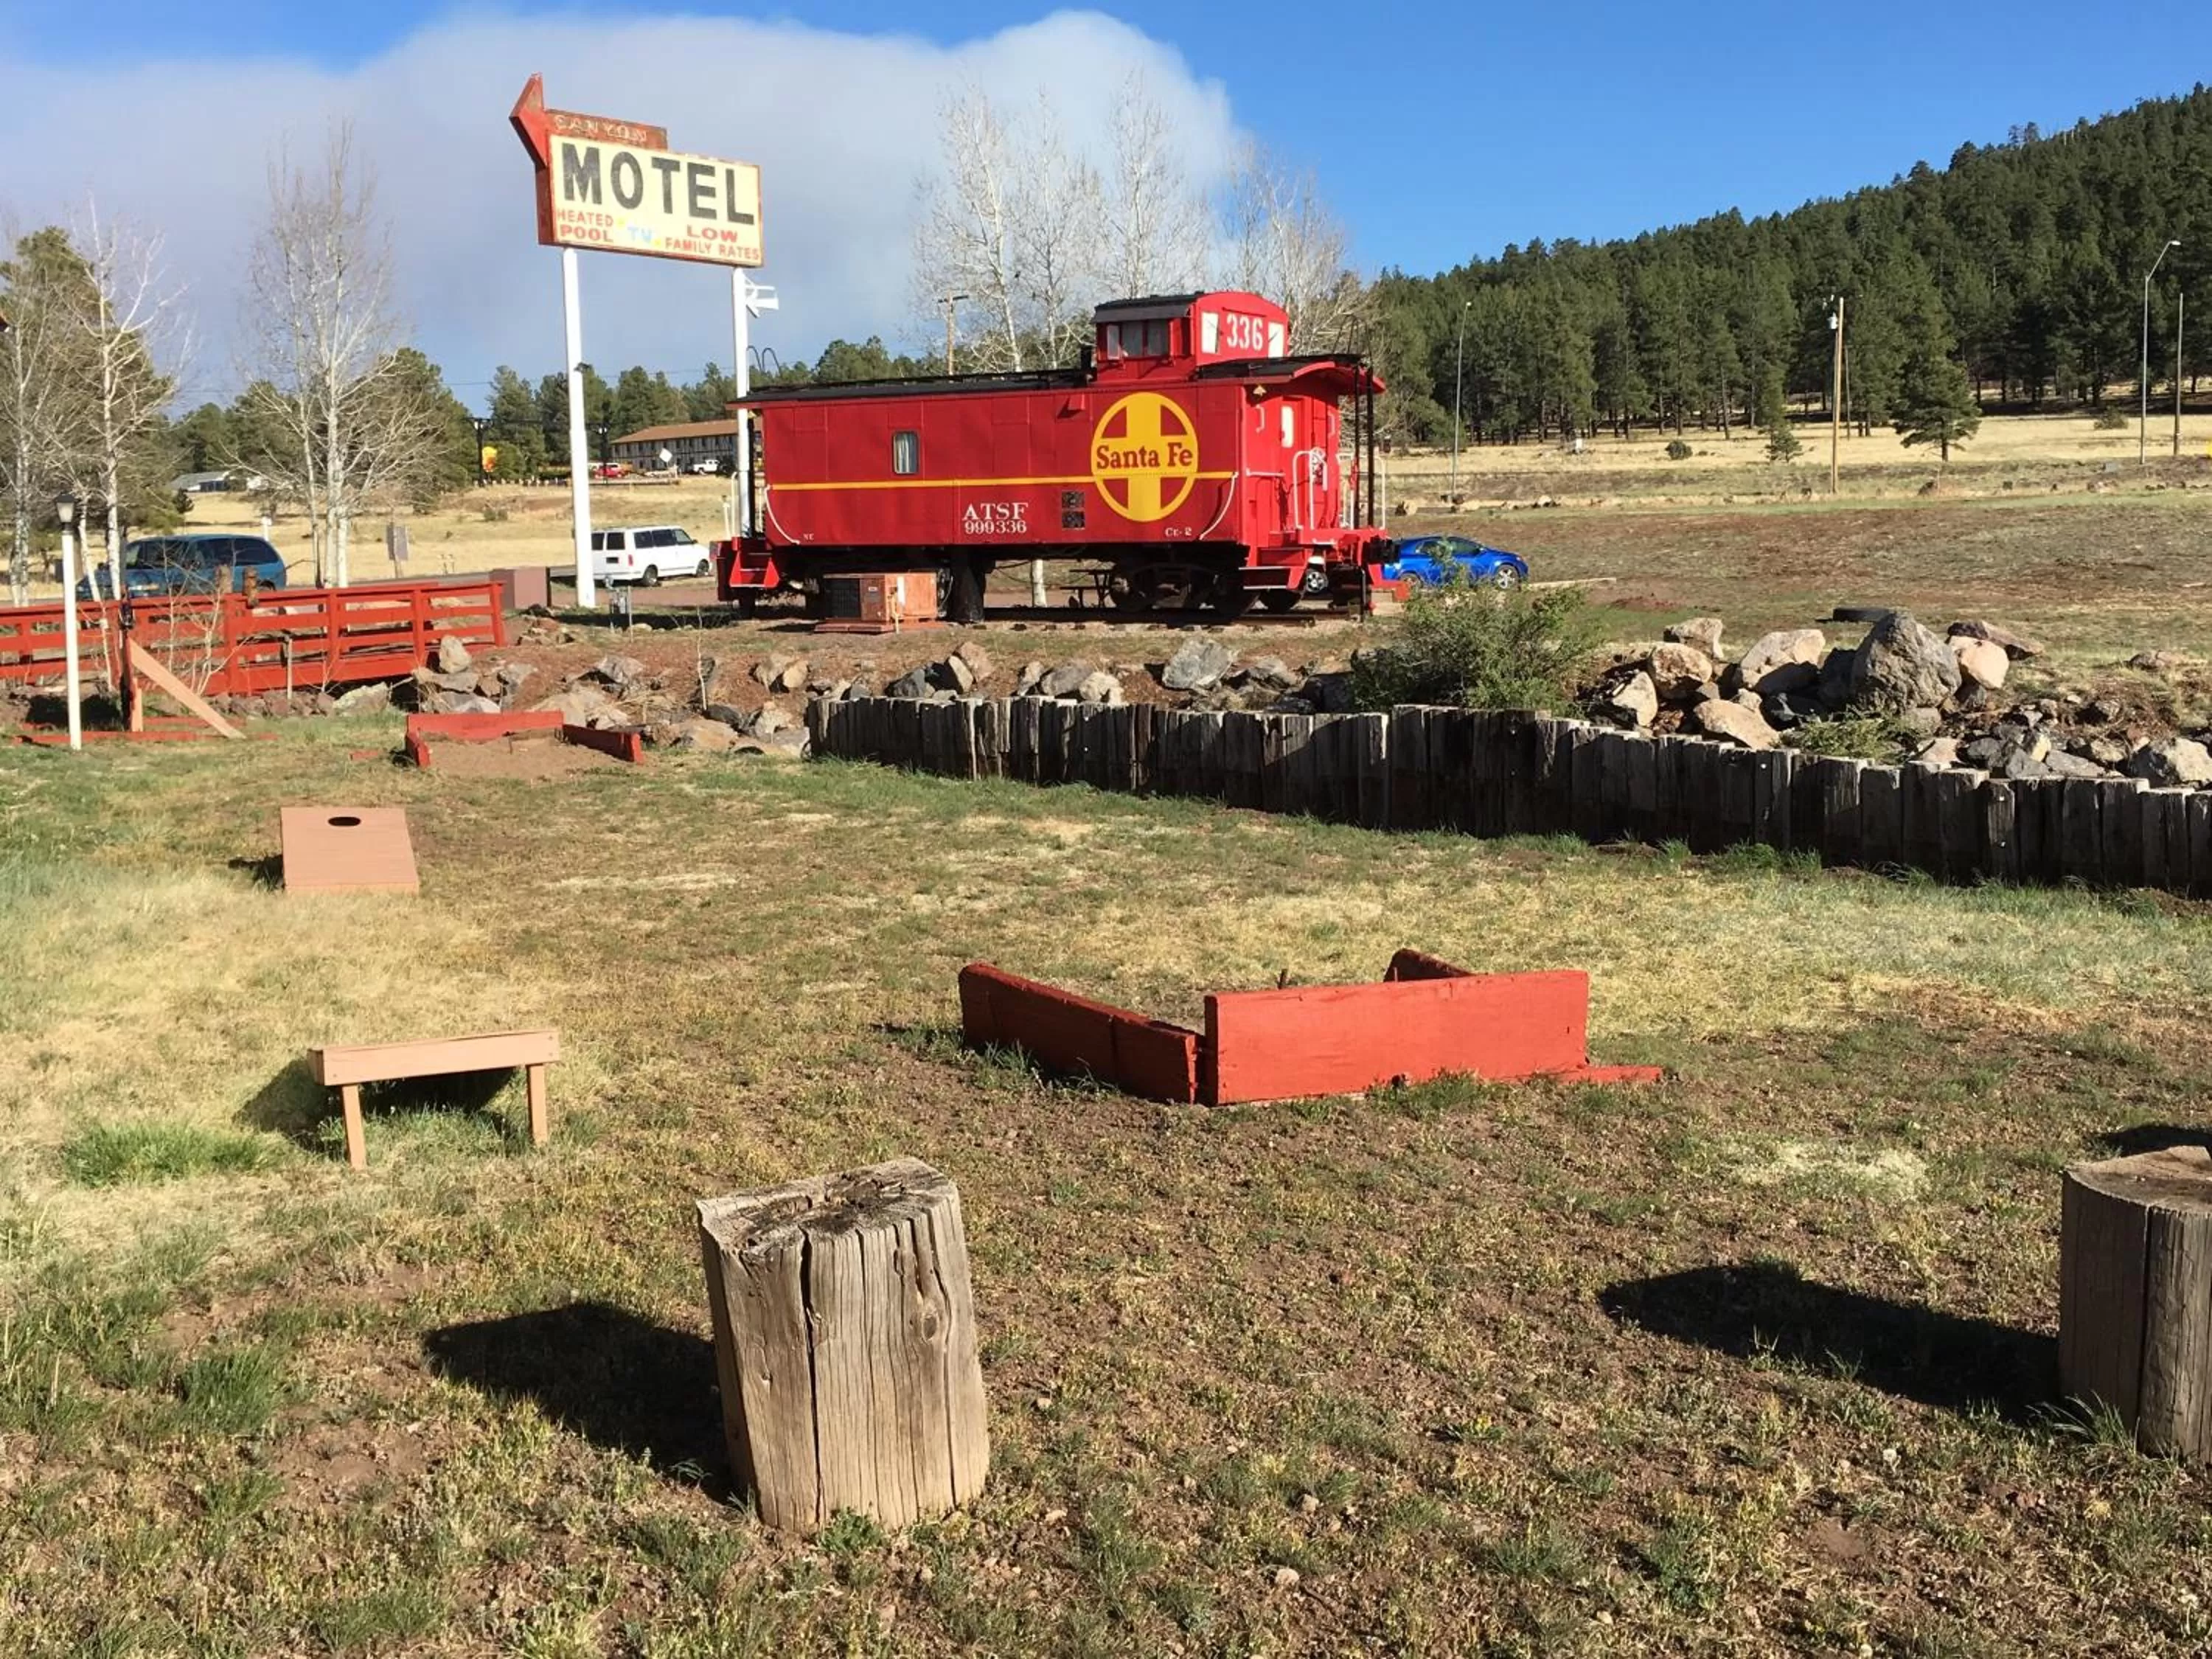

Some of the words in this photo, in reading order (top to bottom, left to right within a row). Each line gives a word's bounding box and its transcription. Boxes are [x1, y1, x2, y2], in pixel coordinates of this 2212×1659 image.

[554, 114, 647, 142] CANYON
[562, 142, 754, 225] MOTEL
[557, 209, 614, 227] HEATED
[560, 224, 614, 243] POOL
[627, 226, 653, 243] TV
[686, 224, 737, 243] LOW
[665, 237, 712, 254] FAMILY
[719, 244, 759, 260] RATES
[1226, 313, 1264, 351] 336
[1096, 445, 1161, 469] Santa
[1168, 442, 1193, 467] Fe
[961, 502, 1029, 521] ATSF
[964, 520, 1027, 535] 999336
